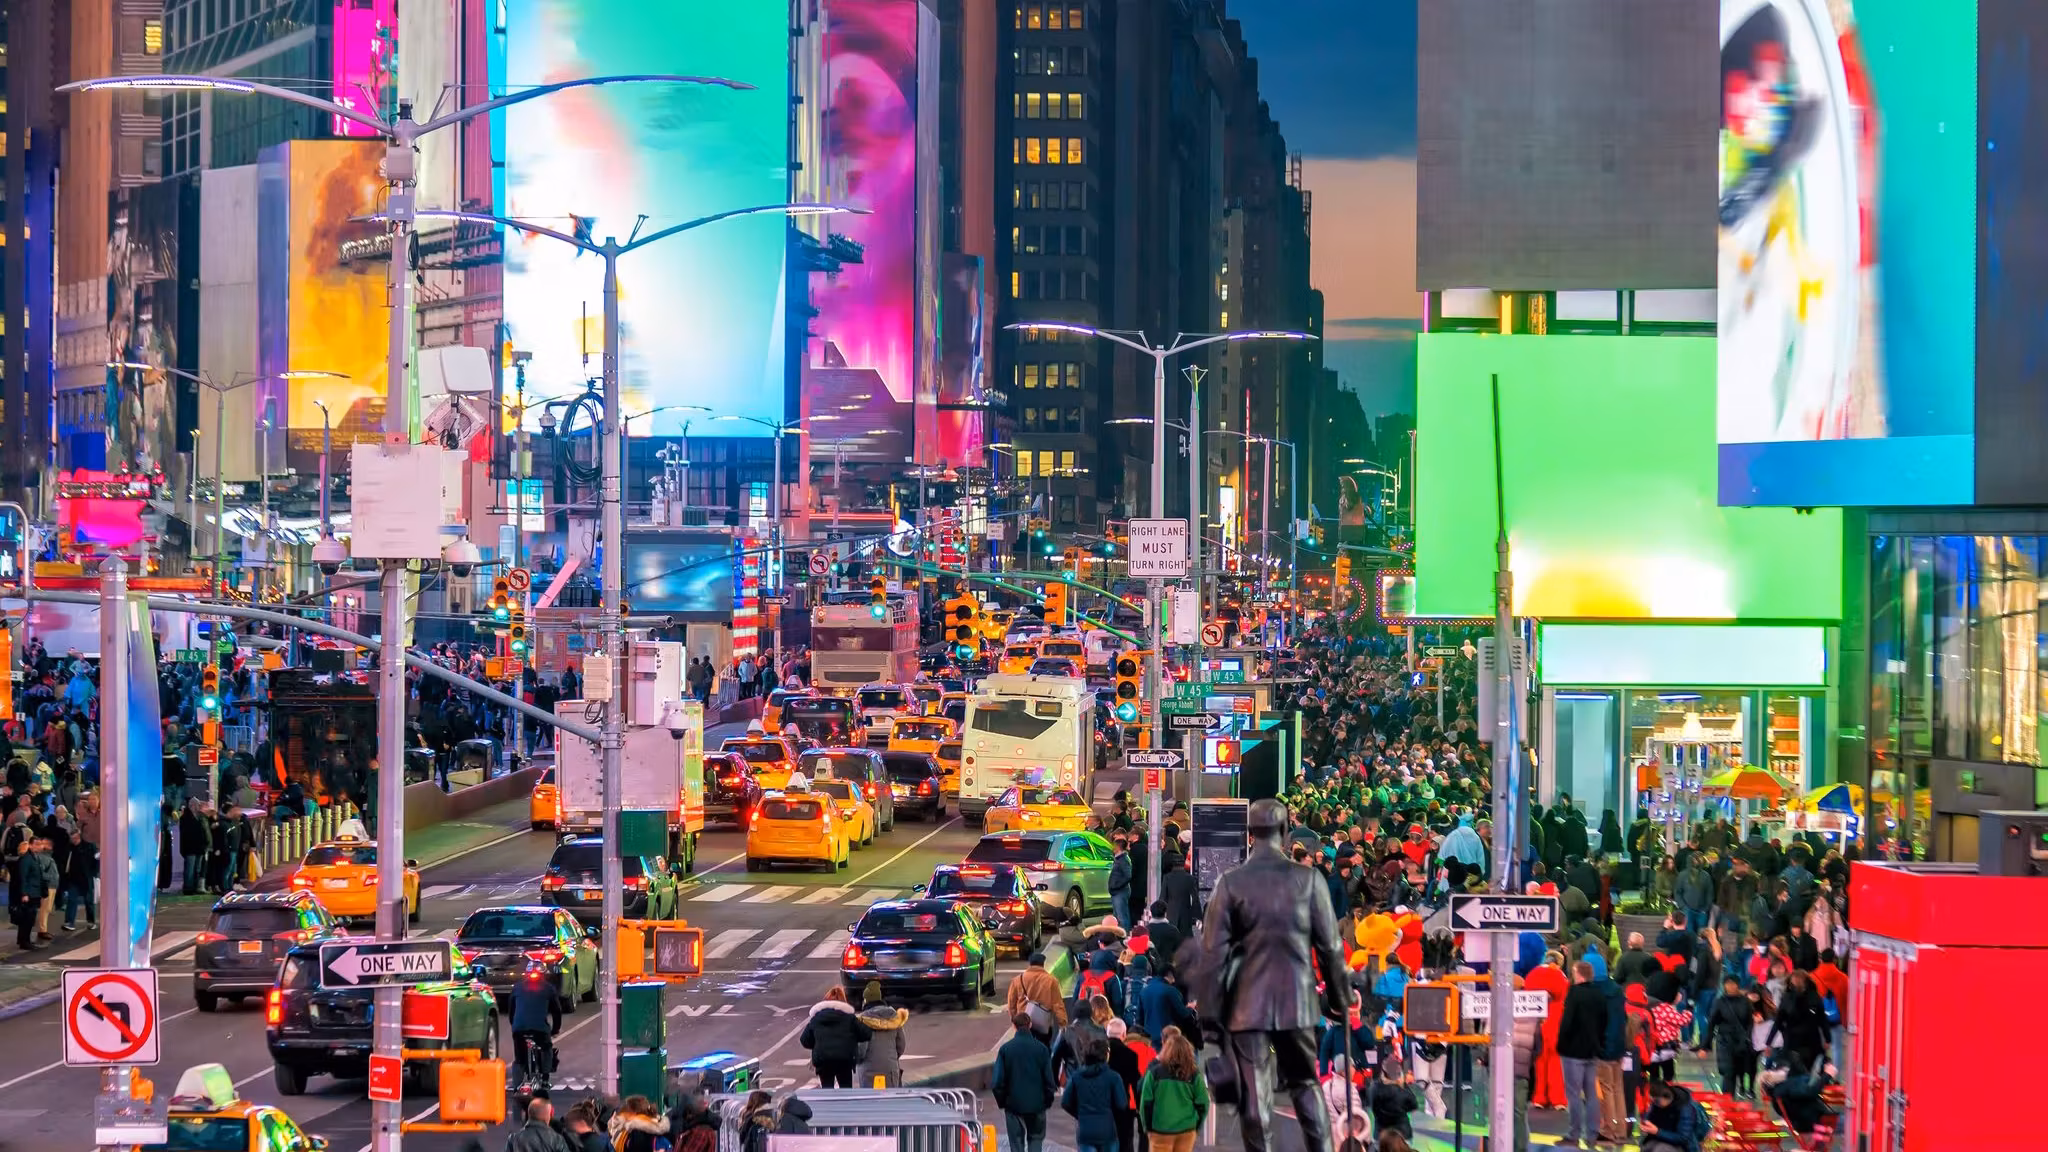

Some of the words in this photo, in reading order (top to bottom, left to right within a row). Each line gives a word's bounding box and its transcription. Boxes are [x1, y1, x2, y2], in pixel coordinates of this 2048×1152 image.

[1131, 526, 1157, 536] RIGHT
[1161, 526, 1185, 536] LANE
[1142, 542, 1173, 554] MUST
[1131, 560, 1154, 570] TURN
[1158, 560, 1185, 570] RIGHT
[177, 650, 186, 661] W
[188, 651, 199, 661] 45
[1212, 671, 1221, 681] W
[1224, 671, 1235, 681] 45
[1176, 685, 1186, 696] W
[1189, 685, 1202, 697] 45
[1161, 700, 1177, 711] George
[1177, 717, 1192, 725] ONE
[1197, 717, 1213, 725] WAY
[1134, 755, 1151, 763] ONE
[1159, 754, 1177, 762] WAY
[1482, 906, 1511, 920] ONE
[1516, 905, 1546, 920] WAY
[360, 956, 395, 973] ONE
[401, 954, 437, 971] WAY
